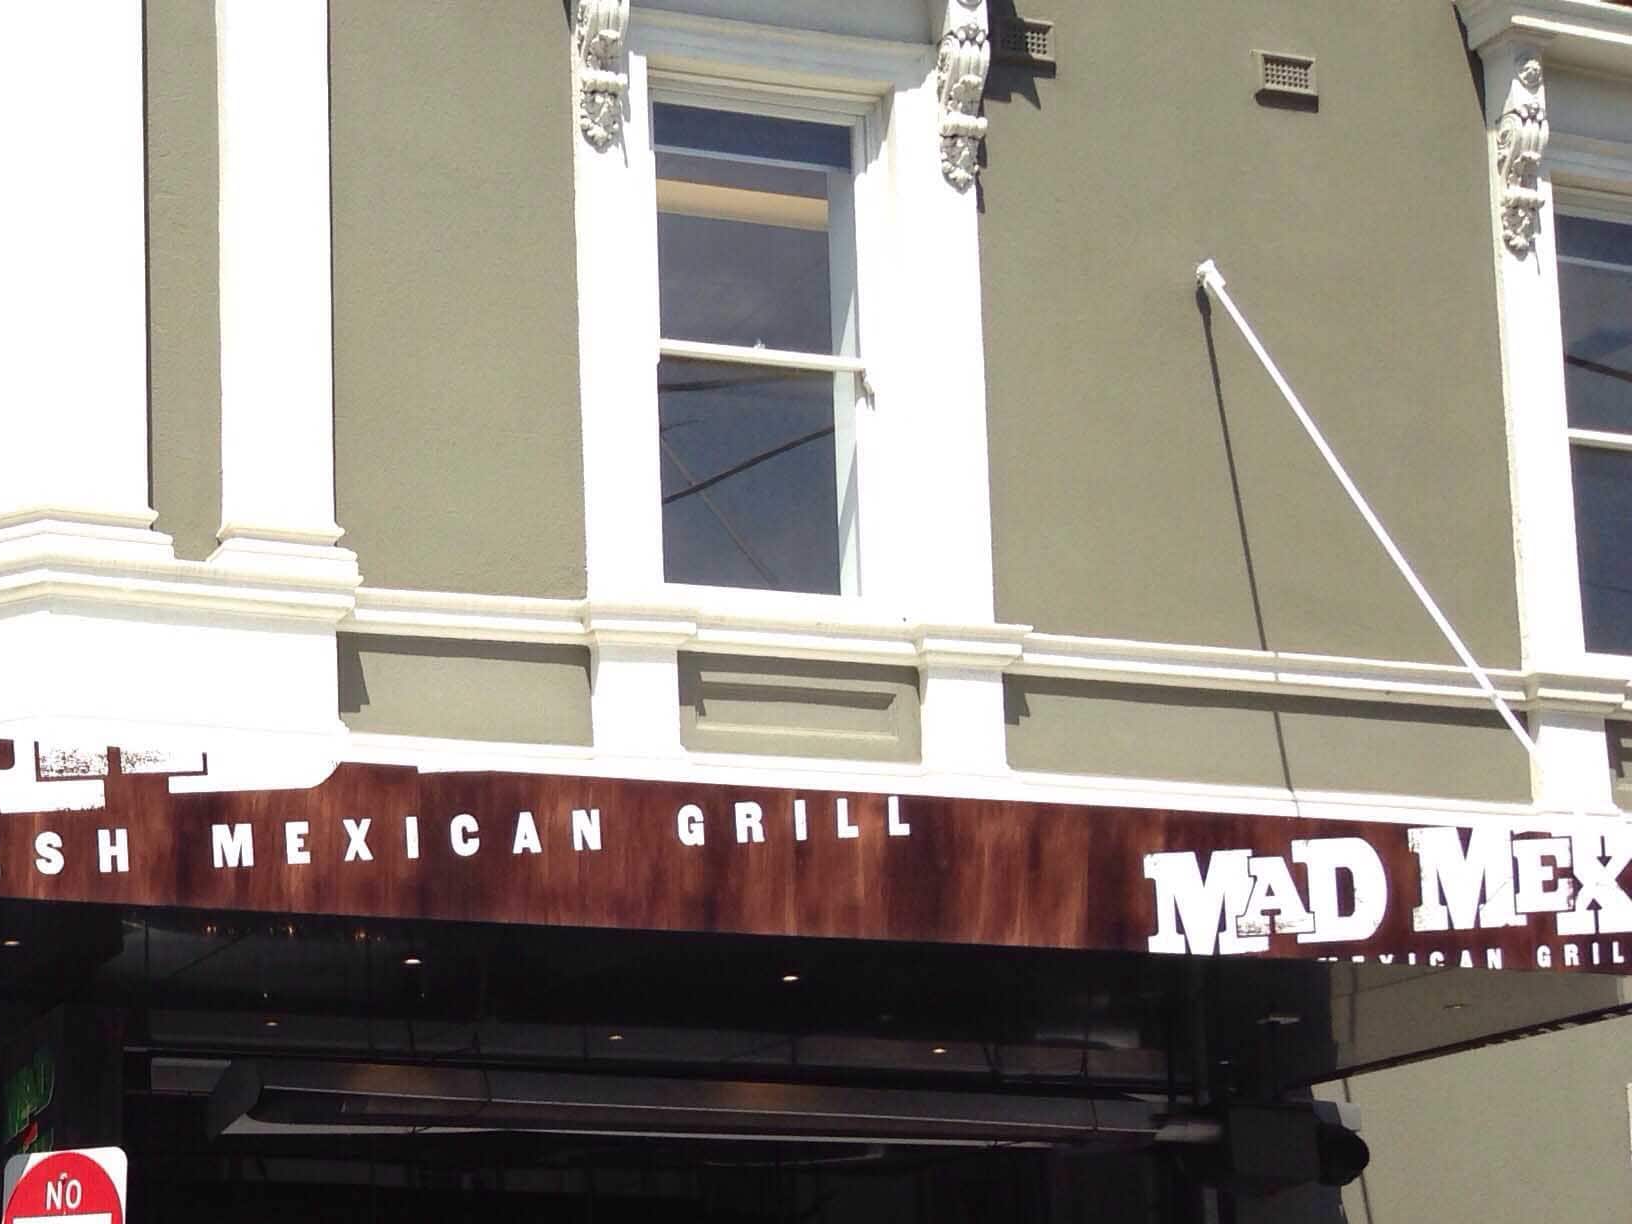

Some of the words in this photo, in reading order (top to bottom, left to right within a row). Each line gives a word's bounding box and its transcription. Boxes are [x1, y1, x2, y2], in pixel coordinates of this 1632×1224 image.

[211, 808, 603, 869] MEXICAN
[677, 795, 911, 847] GRILL
[1143, 836, 1389, 957] MAD
[1407, 826, 1632, 935] MEX
[46, 1179, 82, 1210] NO
